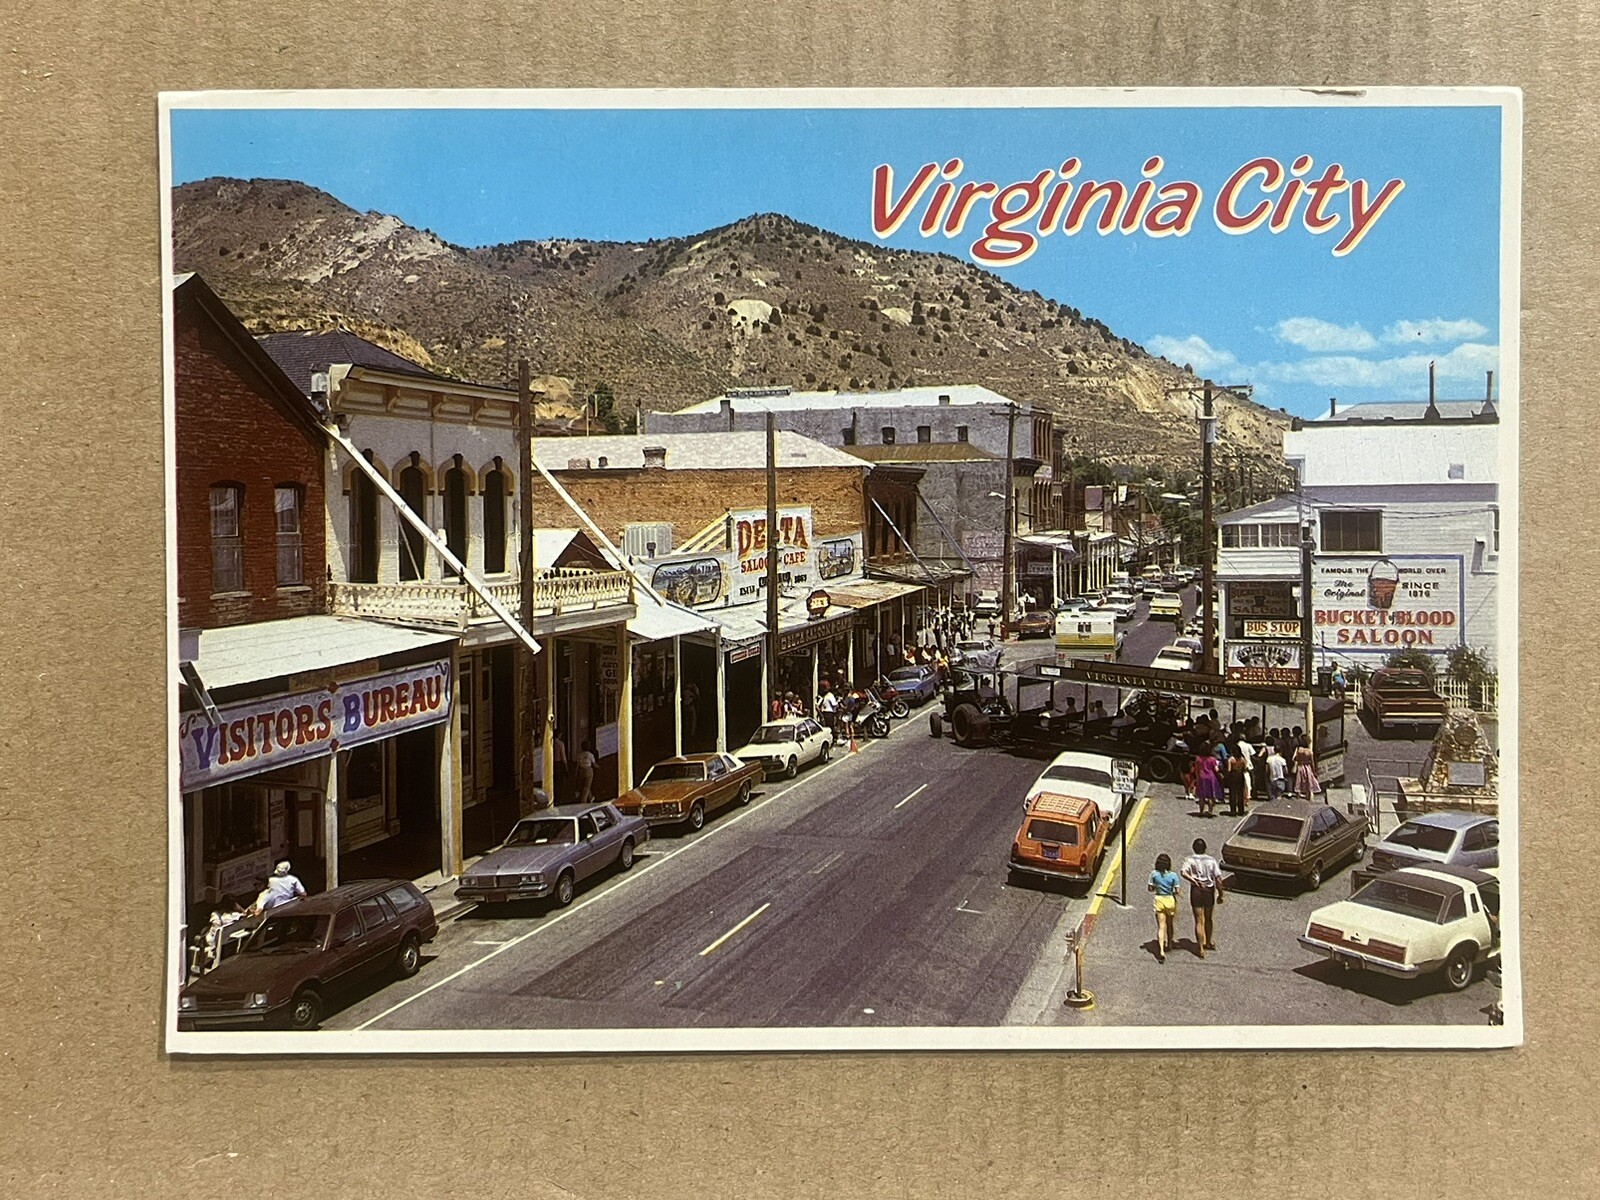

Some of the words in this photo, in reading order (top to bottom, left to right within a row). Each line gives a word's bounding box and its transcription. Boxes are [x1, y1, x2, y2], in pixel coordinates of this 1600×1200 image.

[872, 156, 1202, 266] Virginia
[1213, 153, 1404, 257] City
[783, 551, 806, 566] CAFE
[1334, 580, 1354, 588] The
[1402, 582, 1440, 590] SINCE
[1324, 588, 1366, 601] Original
[1246, 621, 1268, 632] BUS
[1271, 621, 1299, 633] STOP
[1314, 610, 1389, 626] BUCKET
[1395, 610, 1456, 627] BLOOD
[1337, 628, 1434, 645] SALOON
[1086, 671, 1146, 686] VIRGINIA
[1153, 679, 1185, 690] CITY
[1193, 683, 1236, 696] TOURS
[191, 699, 333, 770] VISITORS
[342, 675, 442, 734] BUREAU
